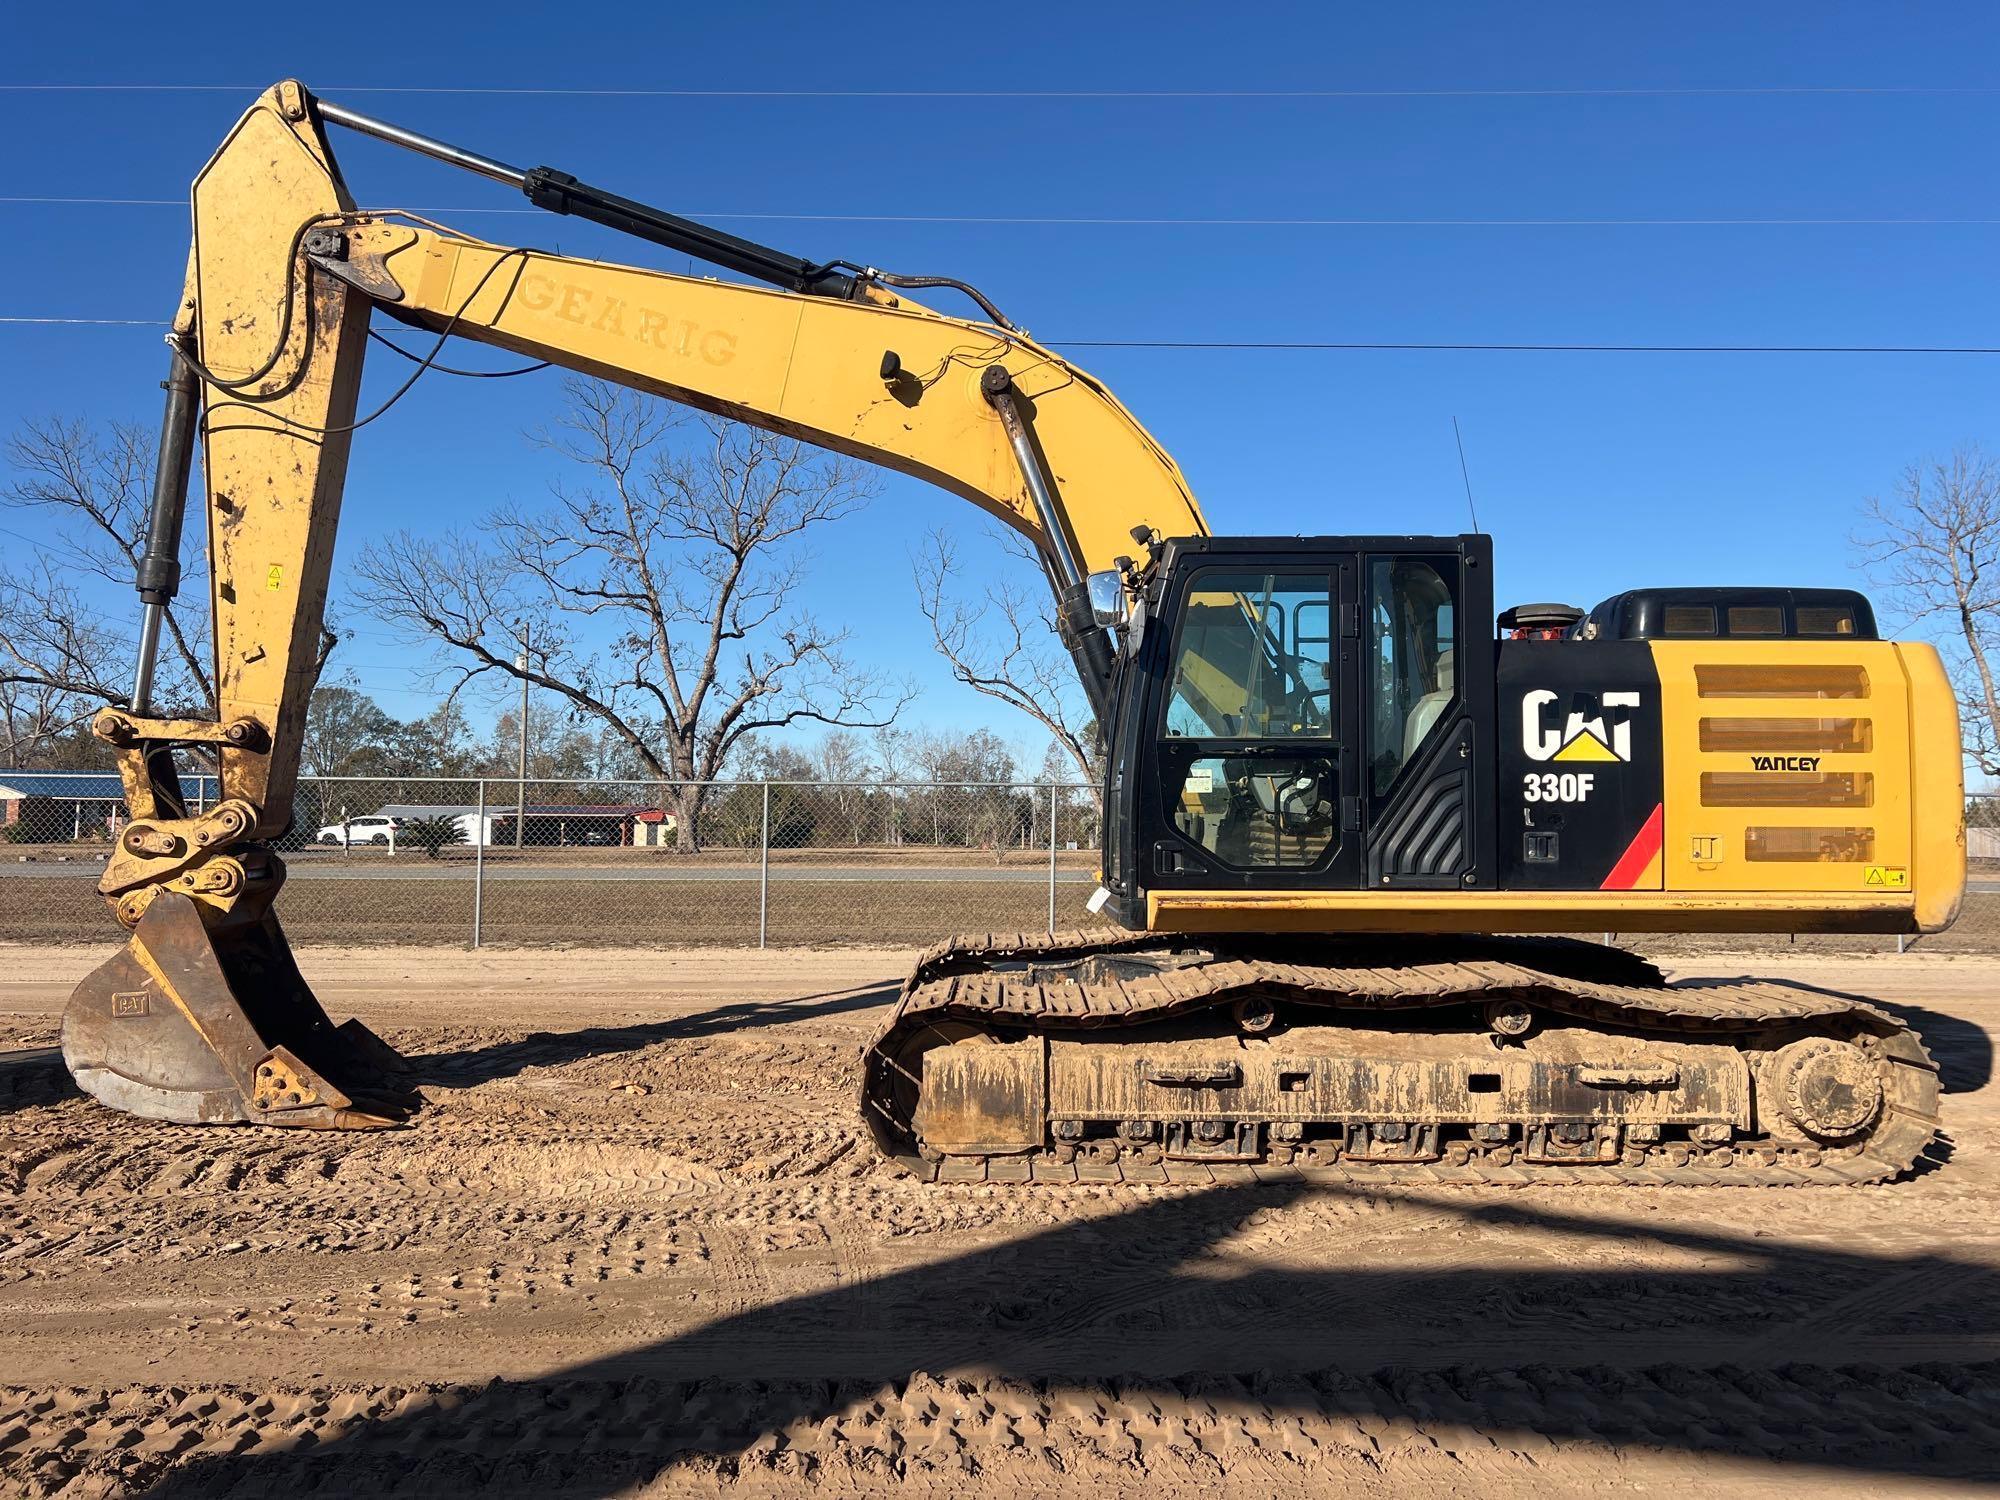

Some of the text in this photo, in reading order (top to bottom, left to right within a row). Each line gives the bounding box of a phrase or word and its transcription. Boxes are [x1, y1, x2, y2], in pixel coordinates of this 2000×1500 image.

[517, 275, 739, 366] GEARIG
[1522, 689, 1640, 762] CAT
[1523, 773, 1594, 802] 330F
[1750, 756, 1821, 771] YANCEY
